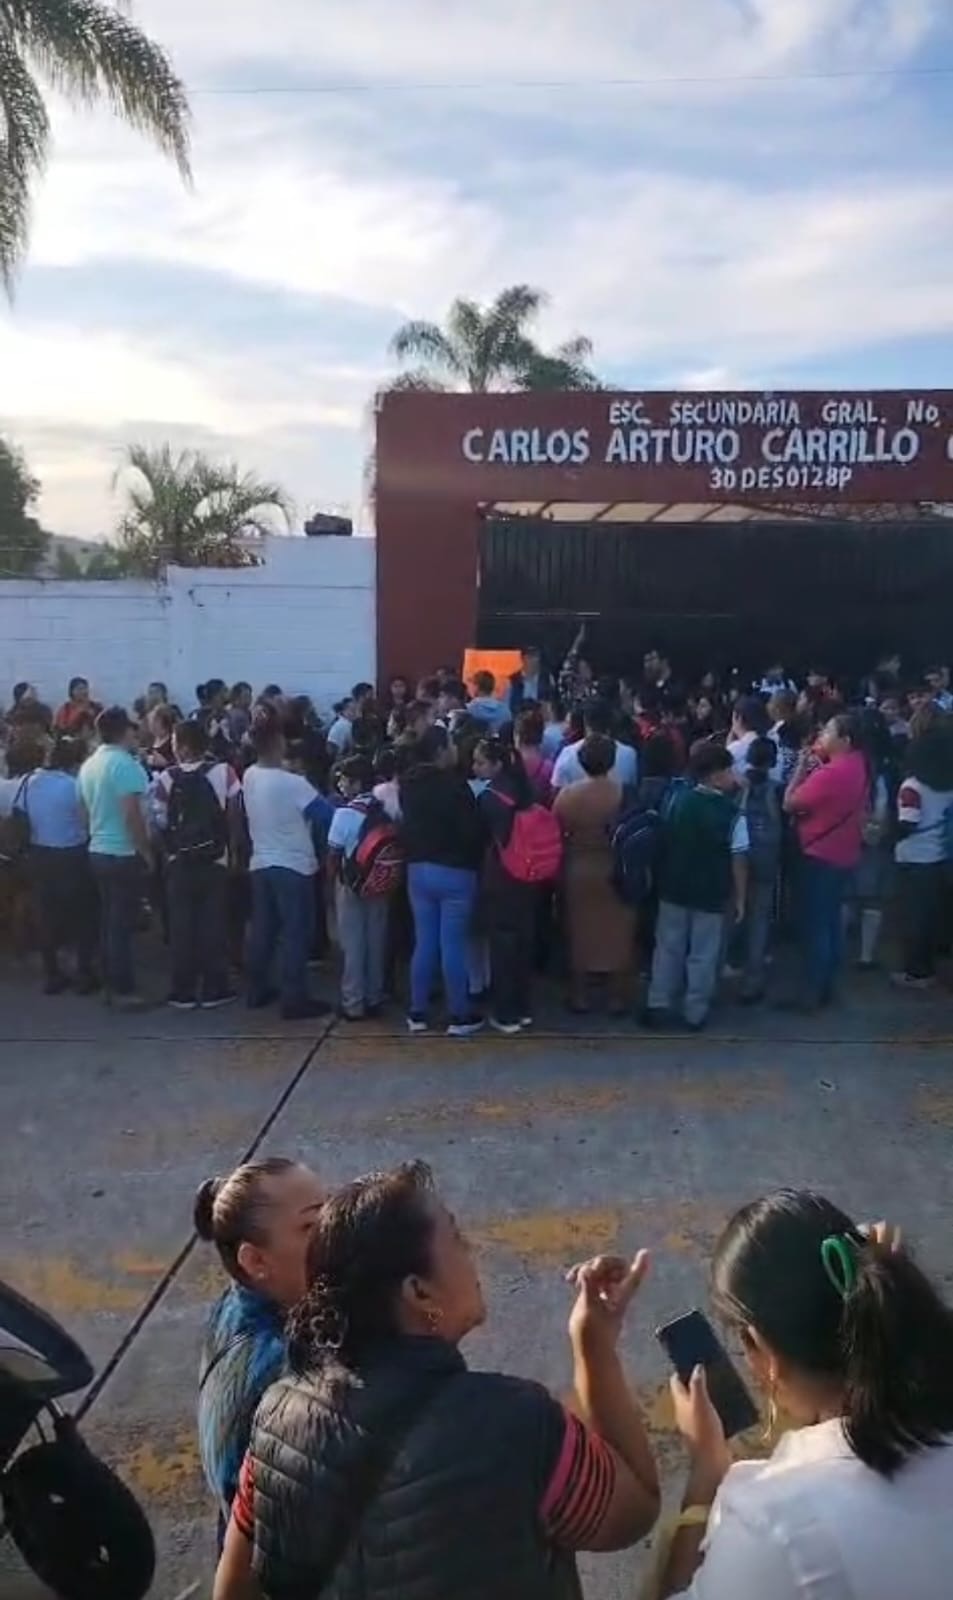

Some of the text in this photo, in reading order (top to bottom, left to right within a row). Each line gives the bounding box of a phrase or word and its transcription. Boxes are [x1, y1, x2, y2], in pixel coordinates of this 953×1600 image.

[669, 401, 800, 425] SECUNDARIA
[821, 401, 886, 425] GRAL.
[462, 427, 590, 463] CARLOS
[605, 427, 740, 463] ARTURO
[761, 426, 919, 464] CARRILLO
